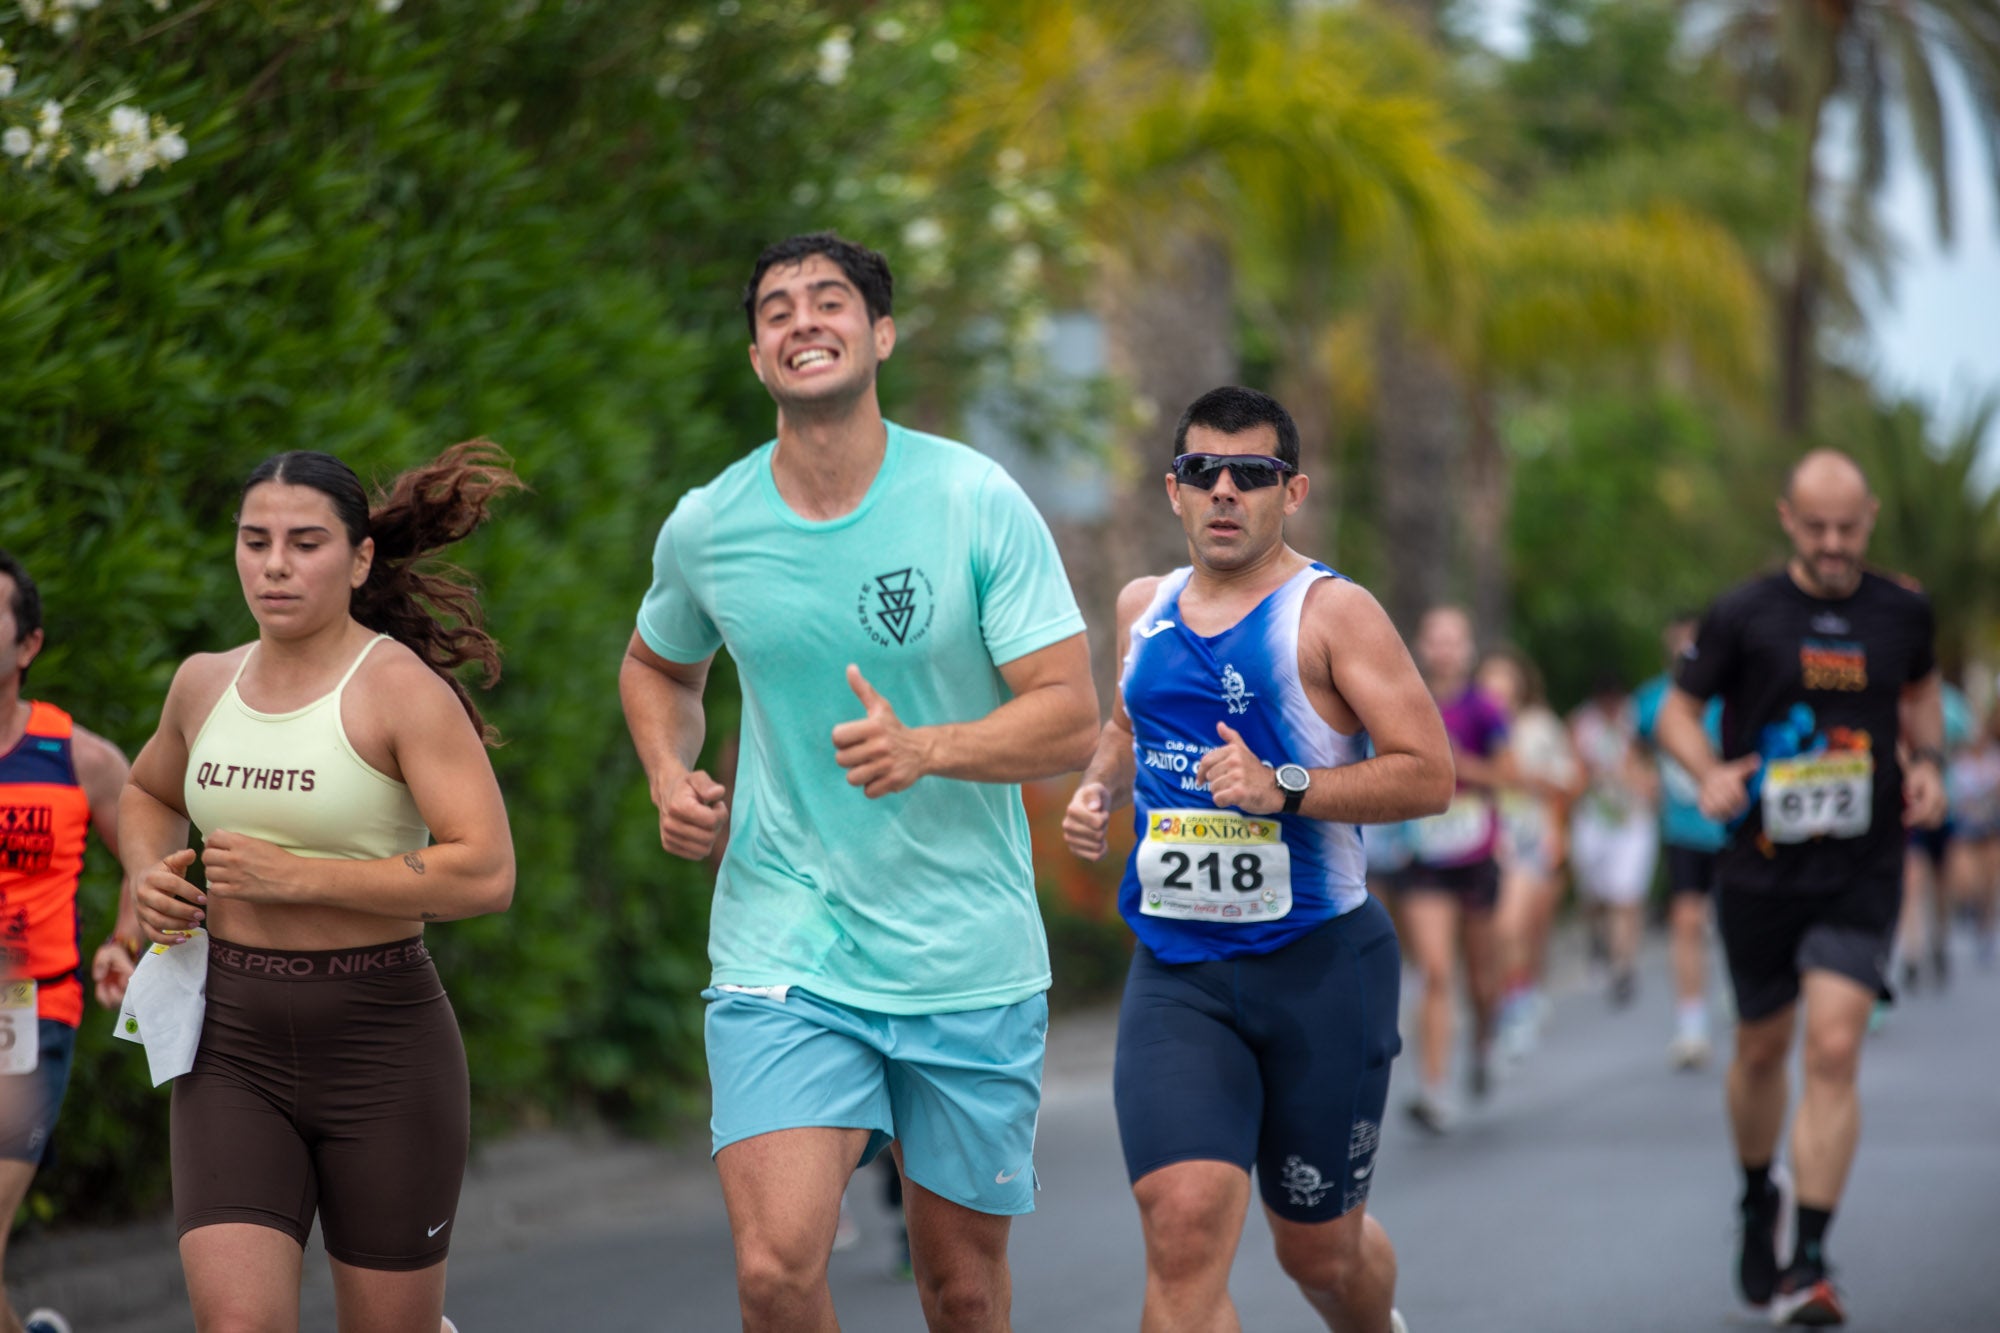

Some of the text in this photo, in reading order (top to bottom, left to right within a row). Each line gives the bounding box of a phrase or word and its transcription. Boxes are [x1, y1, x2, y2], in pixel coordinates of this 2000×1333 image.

[1165, 740, 1185, 751] Club
[1185, 743, 1199, 754] de
[197, 762, 315, 792] QLTYHBTS
[1181, 823, 1251, 840] FONDO
[1160, 851, 1264, 893] 218
[245, 953, 314, 976] PRO
[328, 949, 402, 975] NIKE
